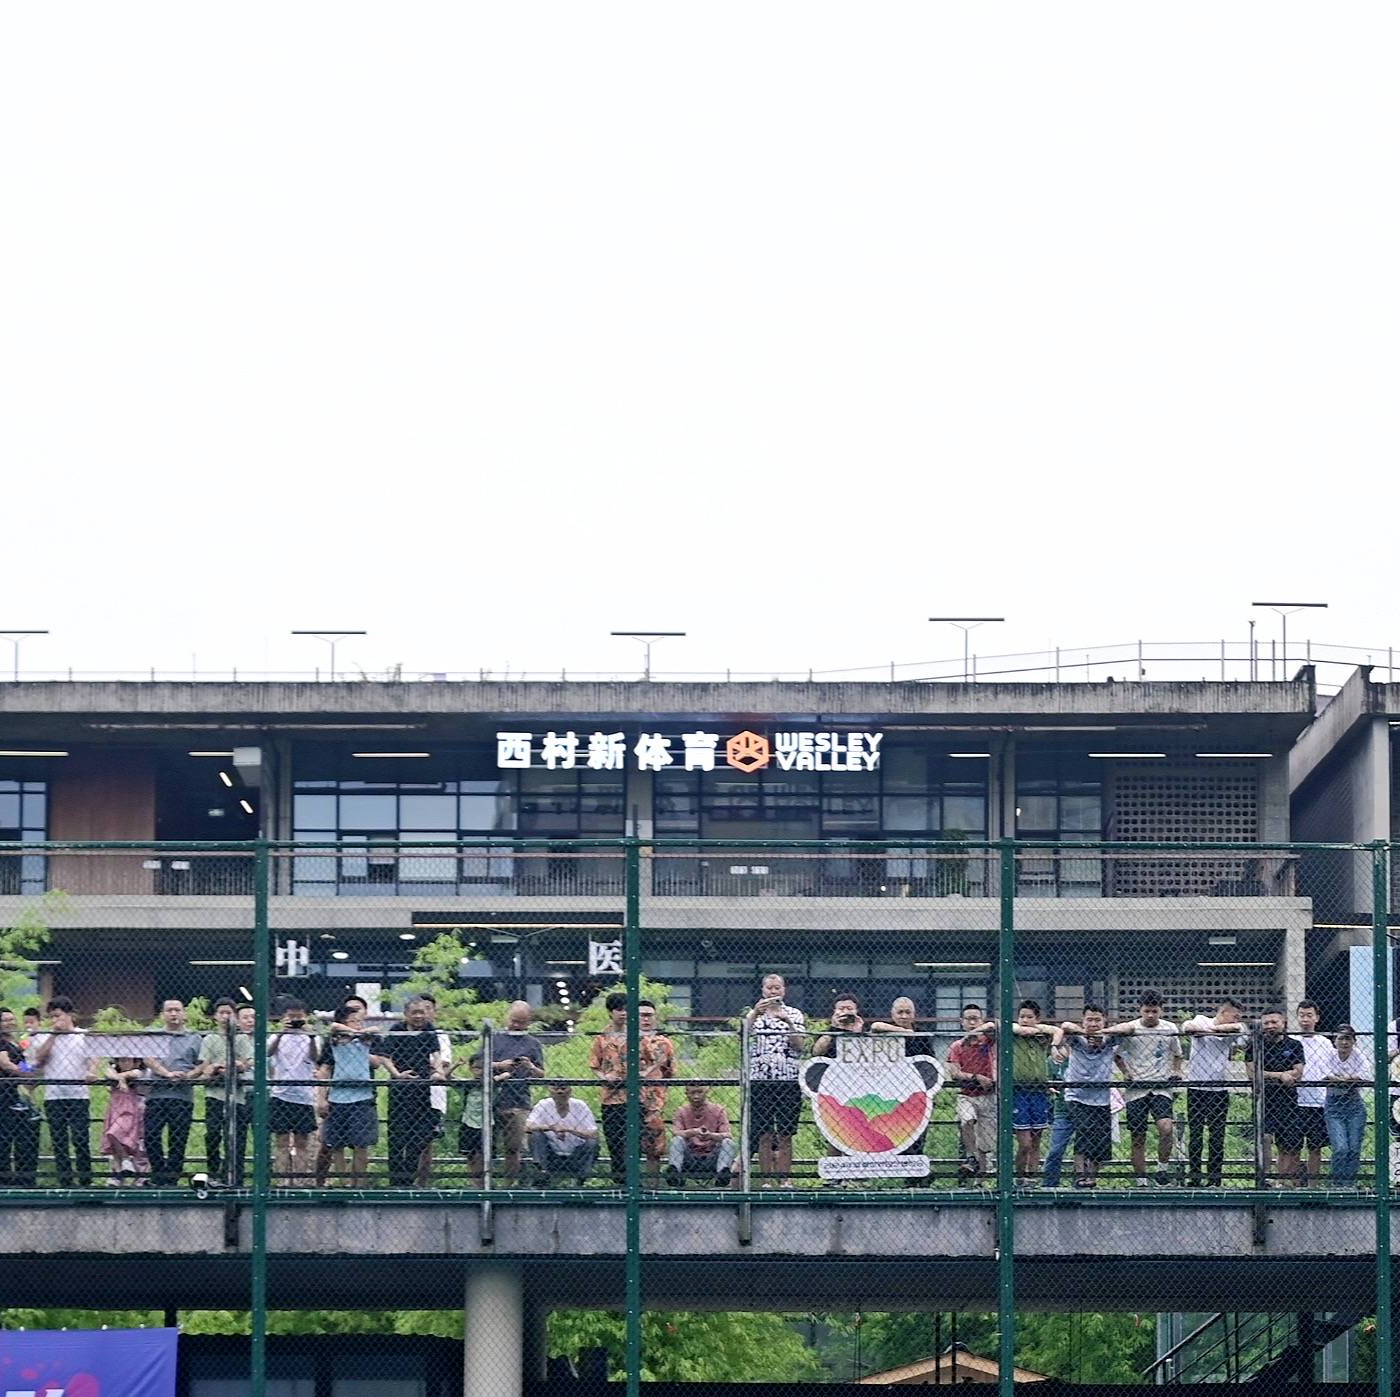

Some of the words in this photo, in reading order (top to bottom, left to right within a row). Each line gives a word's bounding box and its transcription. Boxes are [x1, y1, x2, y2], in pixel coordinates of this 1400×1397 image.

[496, 731, 719, 772] 西村新体育
[775, 732, 883, 751] WESLEY
[776, 752, 880, 772] VALLEY
[842, 1039, 901, 1063] EXPO
